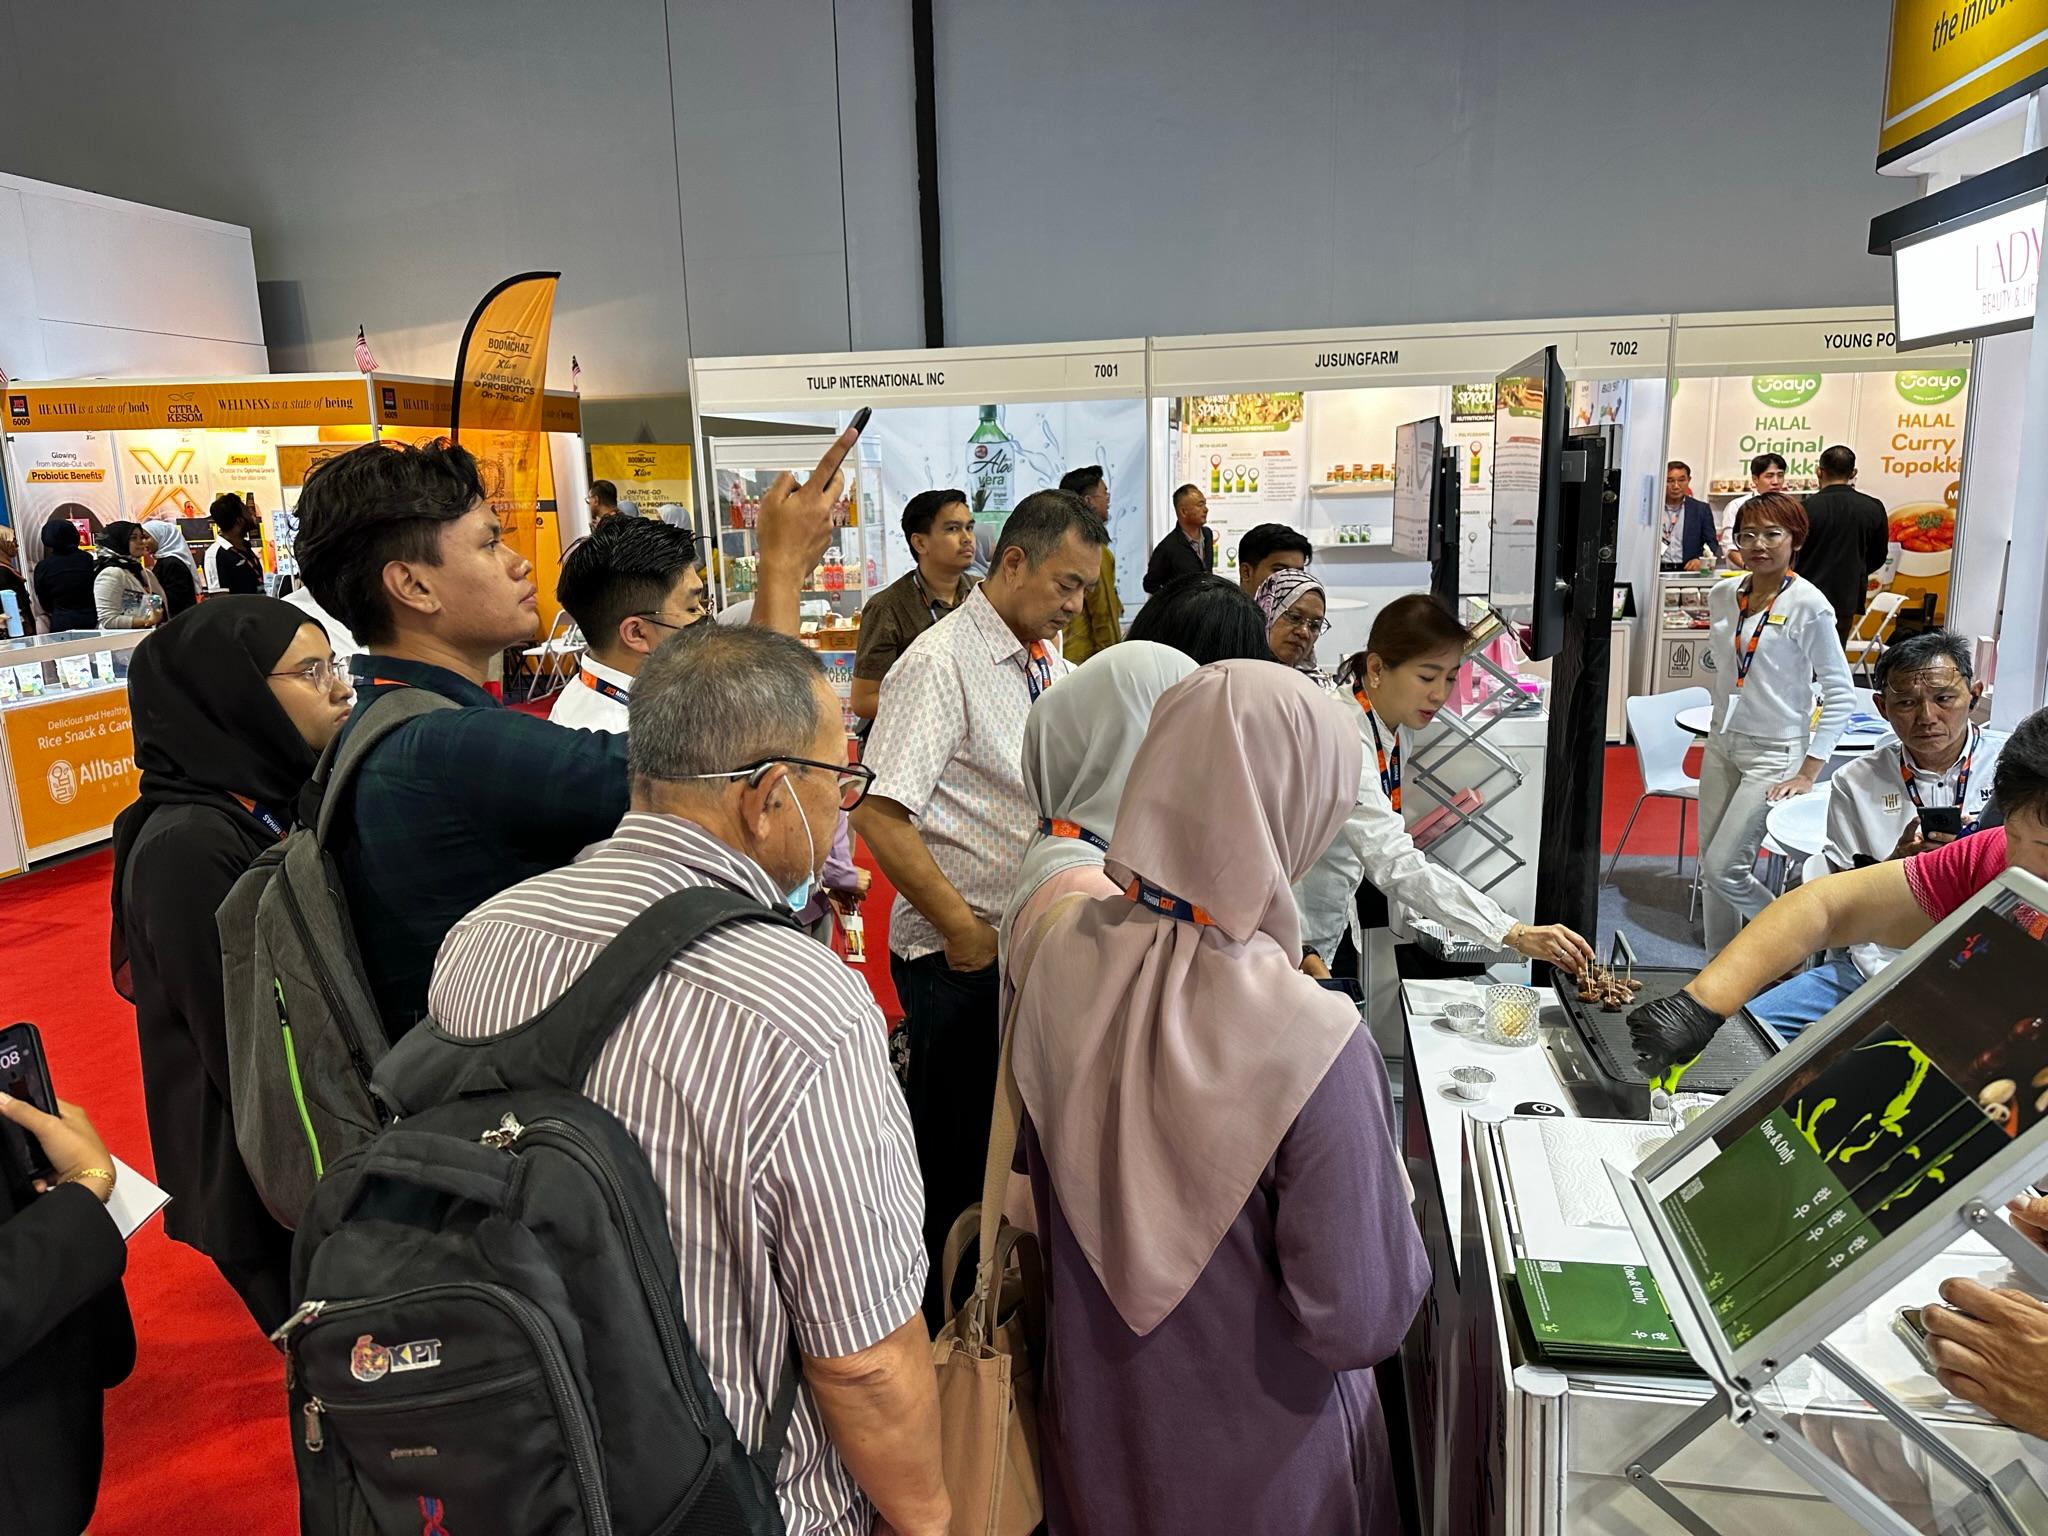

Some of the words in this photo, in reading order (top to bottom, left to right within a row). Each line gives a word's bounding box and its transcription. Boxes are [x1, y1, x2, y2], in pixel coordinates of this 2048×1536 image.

[1931, 11, 1958, 52] the
[1982, 289, 2010, 314] BEAUTY
[488, 338, 530, 353] BOOMCHAZ
[1824, 334, 1872, 349] YOUNG
[1876, 332, 1896, 347] PO
[1610, 341, 1638, 356] 7002
[1314, 350, 1399, 367] JUSUNGFARM
[1094, 364, 1118, 378] 7001
[480, 372, 532, 386] KOMBUCHA
[807, 376, 837, 390] TULIP
[839, 373, 924, 389] INTERNATIONAL
[926, 371, 945, 386] INC
[481, 381, 535, 395] PROBIOTICS
[218, 399, 270, 411] WELLNESS
[272, 401, 279, 410] is
[291, 399, 311, 410] state
[313, 397, 324, 411] of
[325, 396, 353, 410] being
[1457, 391, 1495, 406] SPROU
[38, 403, 76, 415] HEALTH
[79, 406, 85, 414] is
[88, 406, 93, 414] a
[128, 402, 149, 415] body
[168, 404, 200, 414] CITRA
[12, 418, 30, 426] 6009
[167, 413, 203, 423] KESOM
[1755, 416, 1811, 431] HALAL
[1898, 414, 1955, 428] HALAL
[1739, 435, 1824, 455] Original
[1891, 433, 1956, 455] Curry
[51, 452, 77, 460] Glowing
[231, 456, 249, 464] Smart
[967, 448, 1012, 474] Aloe
[1881, 456, 1961, 478] Topokki
[31, 472, 68, 480] Probiotic
[71, 471, 102, 480] Benefits
[179, 474, 199, 485] YOUR
[978, 474, 1005, 486] vera
[1947, 490, 1958, 499] M
[828, 666, 853, 675] ALOE
[829, 674, 853, 683] VERA
[48, 716, 83, 730] Delicious
[85, 712, 99, 722] and
[100, 706, 128, 719] Healthy
[37, 736, 62, 750] Rice
[65, 726, 96, 744] Snack
[98, 723, 107, 736] &
[109, 720, 132, 733] Can
[80, 756, 138, 785] Allbar
[262, 814, 281, 835] MIHAS
[0, 1051, 20, 1069] 08
[1760, 1119, 1773, 1140] One
[1770, 1134, 1778, 1146] &
[1775, 1140, 1795, 1166] Only
[1623, 1265, 1635, 1280] One
[1630, 1278, 1640, 1287] &
[1631, 1287, 1648, 1305] Only
[391, 1342, 441, 1367] KPT
